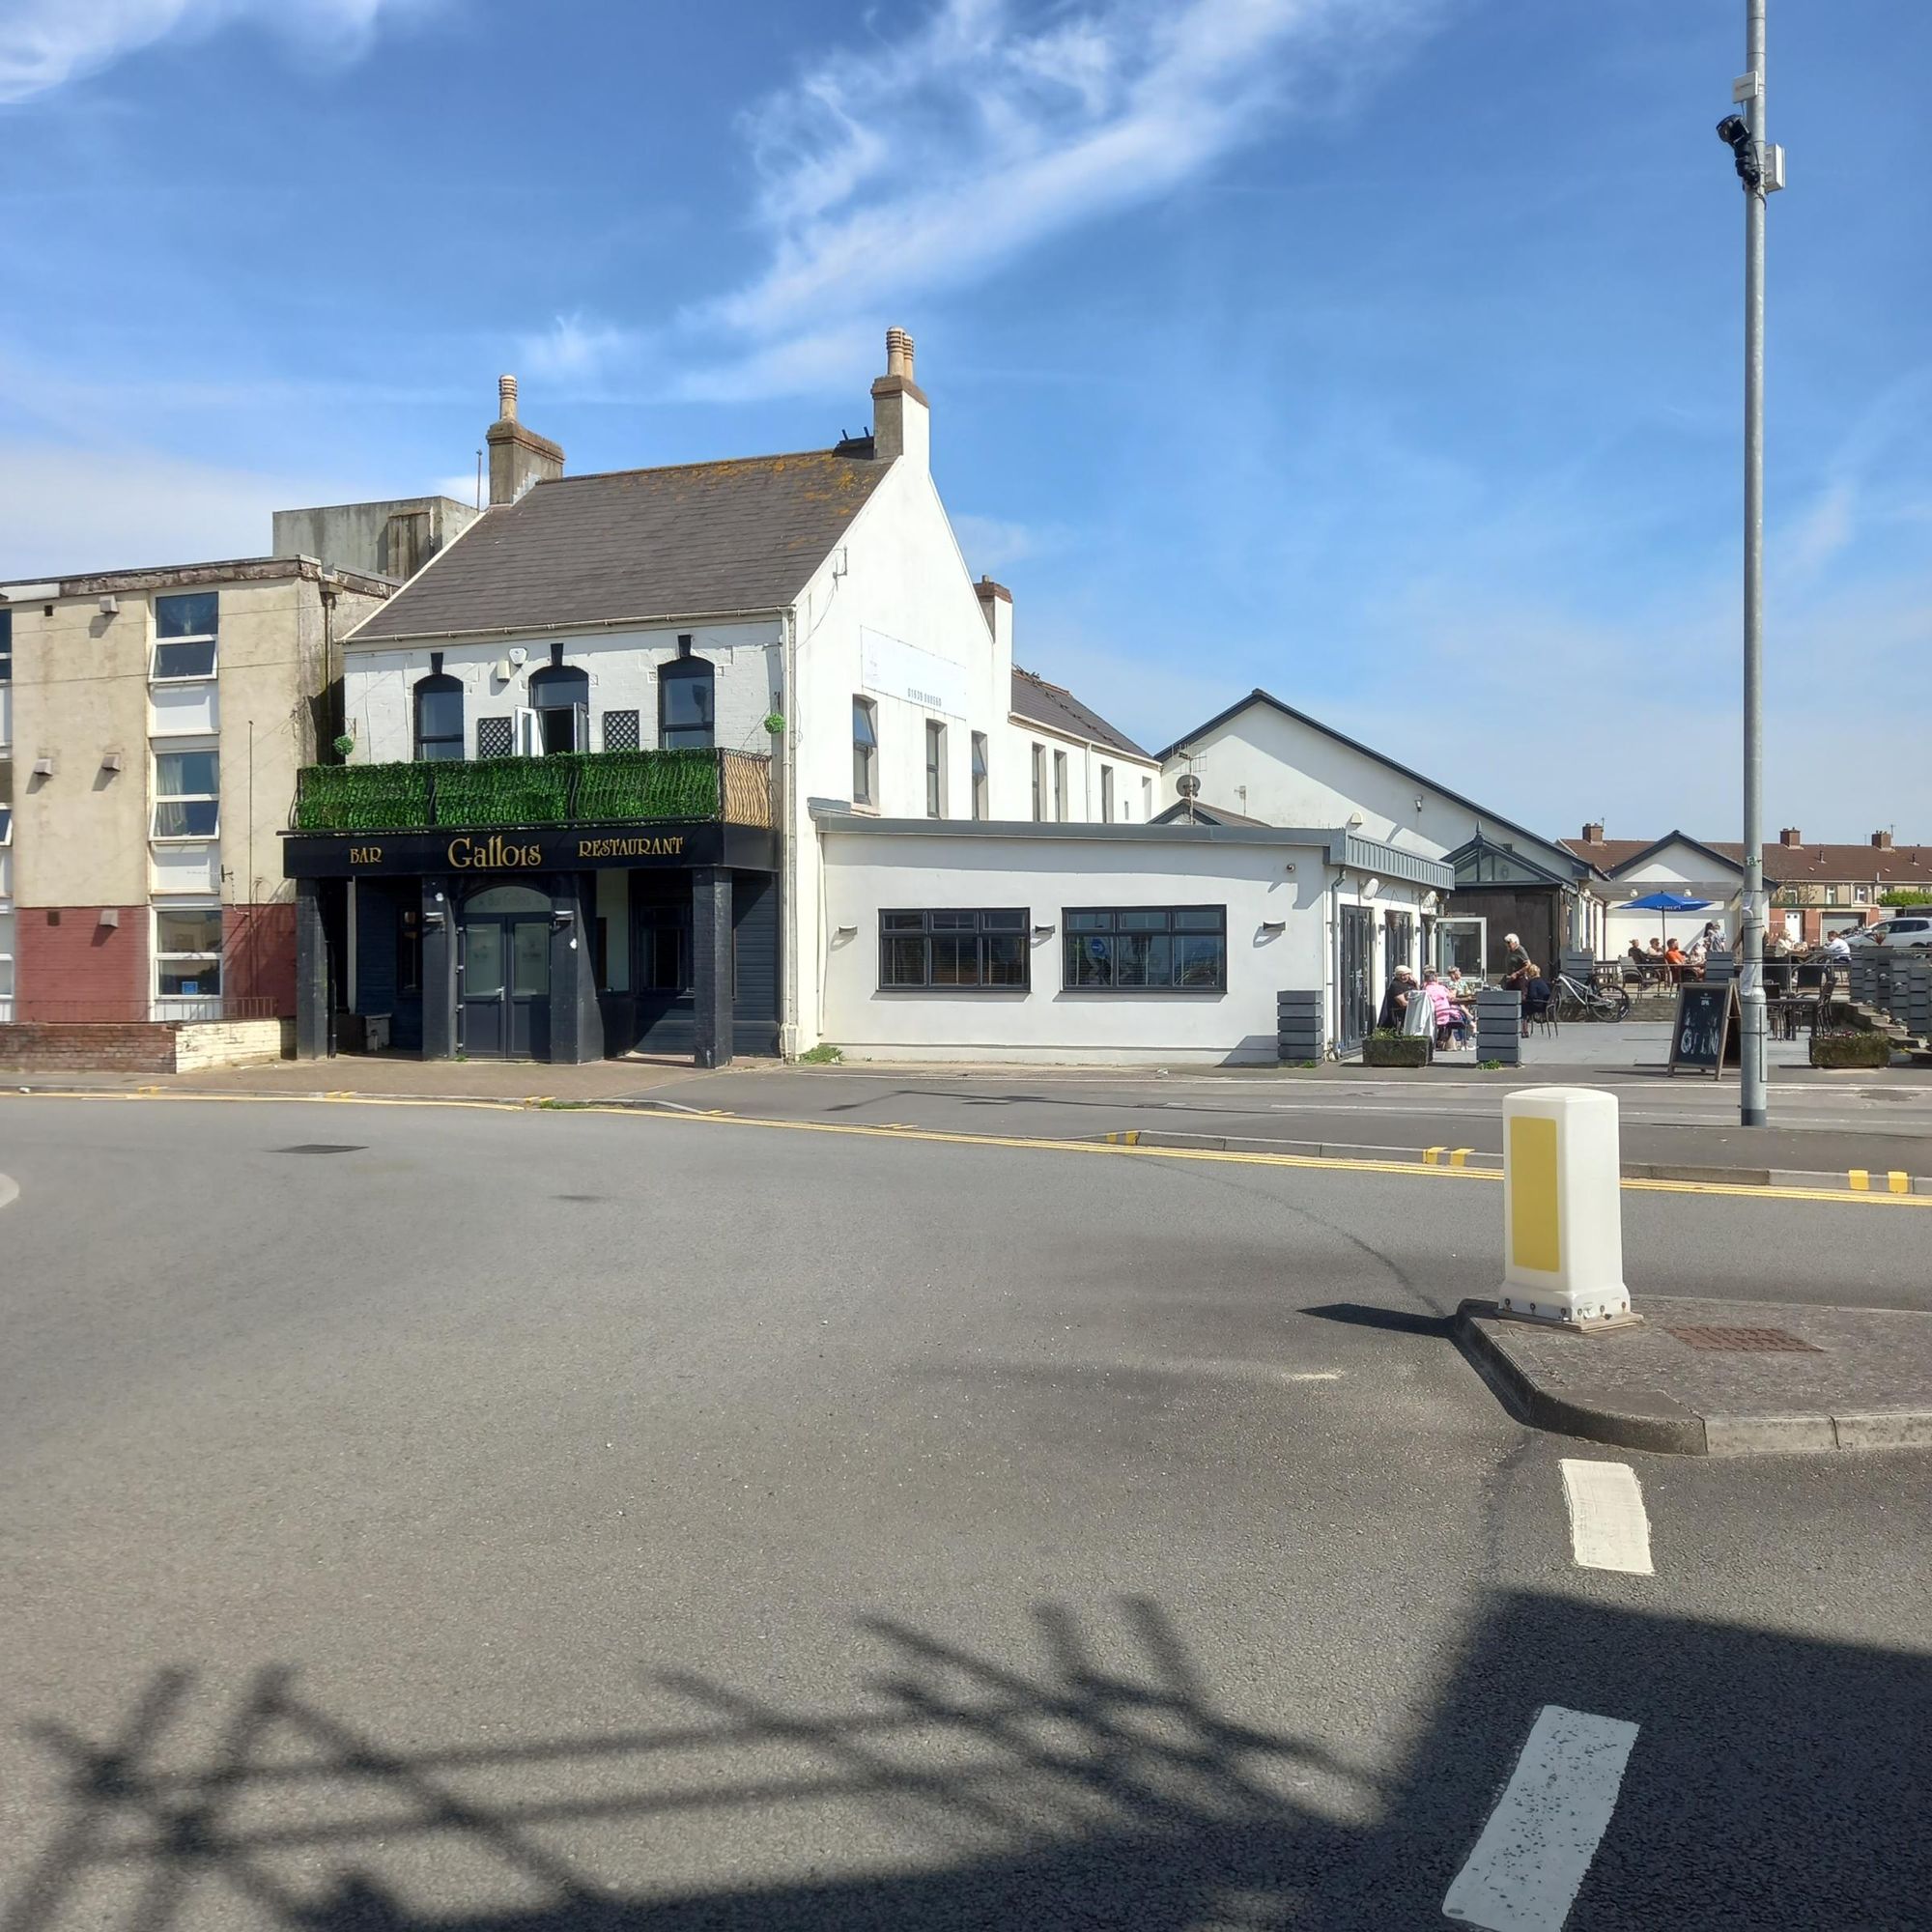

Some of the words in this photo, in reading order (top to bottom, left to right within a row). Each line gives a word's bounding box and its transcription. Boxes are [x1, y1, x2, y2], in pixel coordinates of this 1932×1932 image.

[350, 846, 382, 864] BAR
[447, 835, 542, 867] Gallois
[579, 837, 684, 857] RESTAURANT
